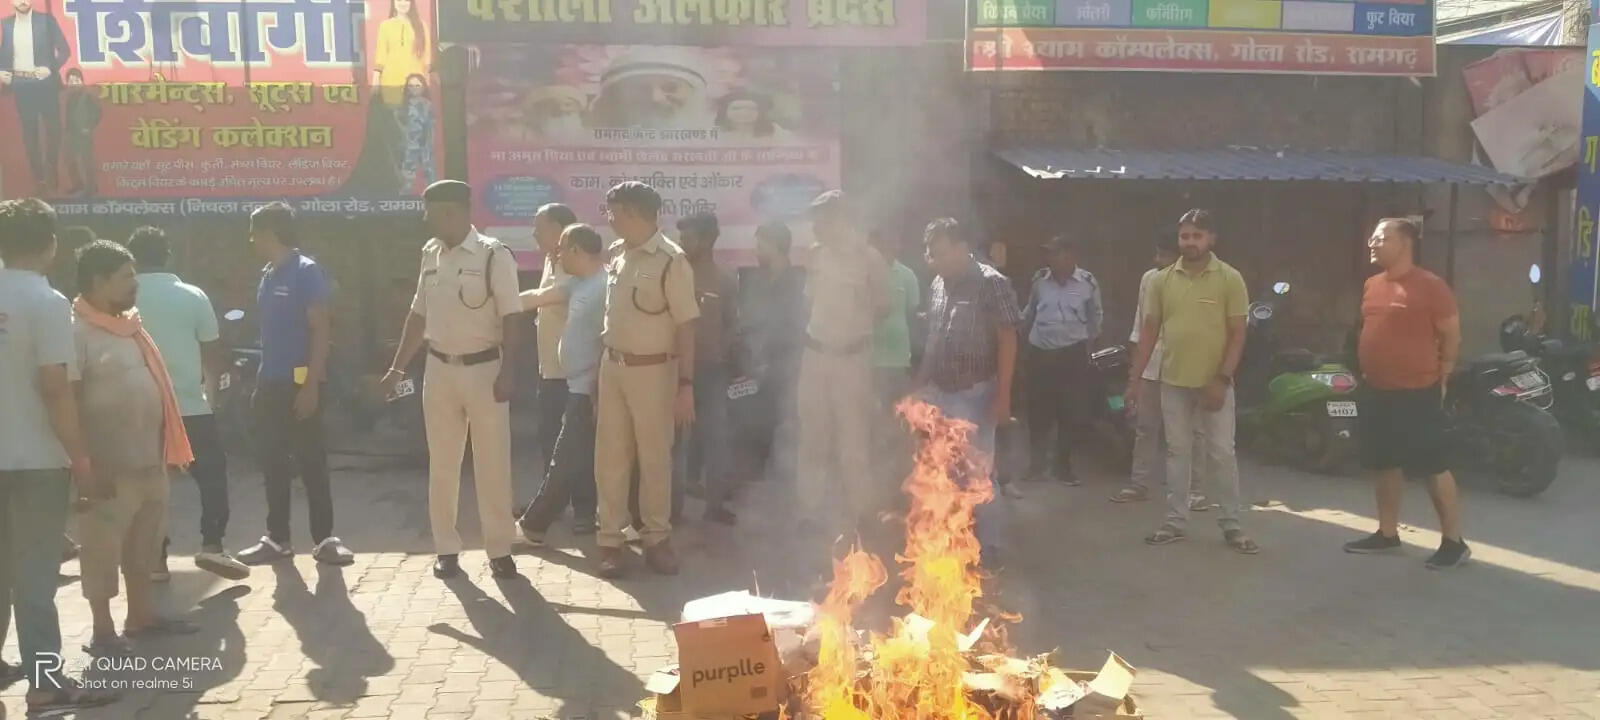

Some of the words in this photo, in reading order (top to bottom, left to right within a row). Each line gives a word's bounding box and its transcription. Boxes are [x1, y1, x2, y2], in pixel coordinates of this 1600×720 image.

[1366, 10, 1385, 30] फुट
[1388, 8, 1416, 27] वियर
[1022, 41, 1082, 59] श्याम
[1231, 36, 1286, 62] गोला
[1346, 46, 1418, 69] रामगढ़
[250, 81, 313, 112] सूट्स
[129, 117, 200, 148] वेडिंग
[210, 117, 333, 148] कलेक्शन
[678, 172, 698, 189] एवं
[700, 172, 743, 188] ओंकार
[300, 197, 340, 212] गोला
[692, 658, 766, 688] purplle
